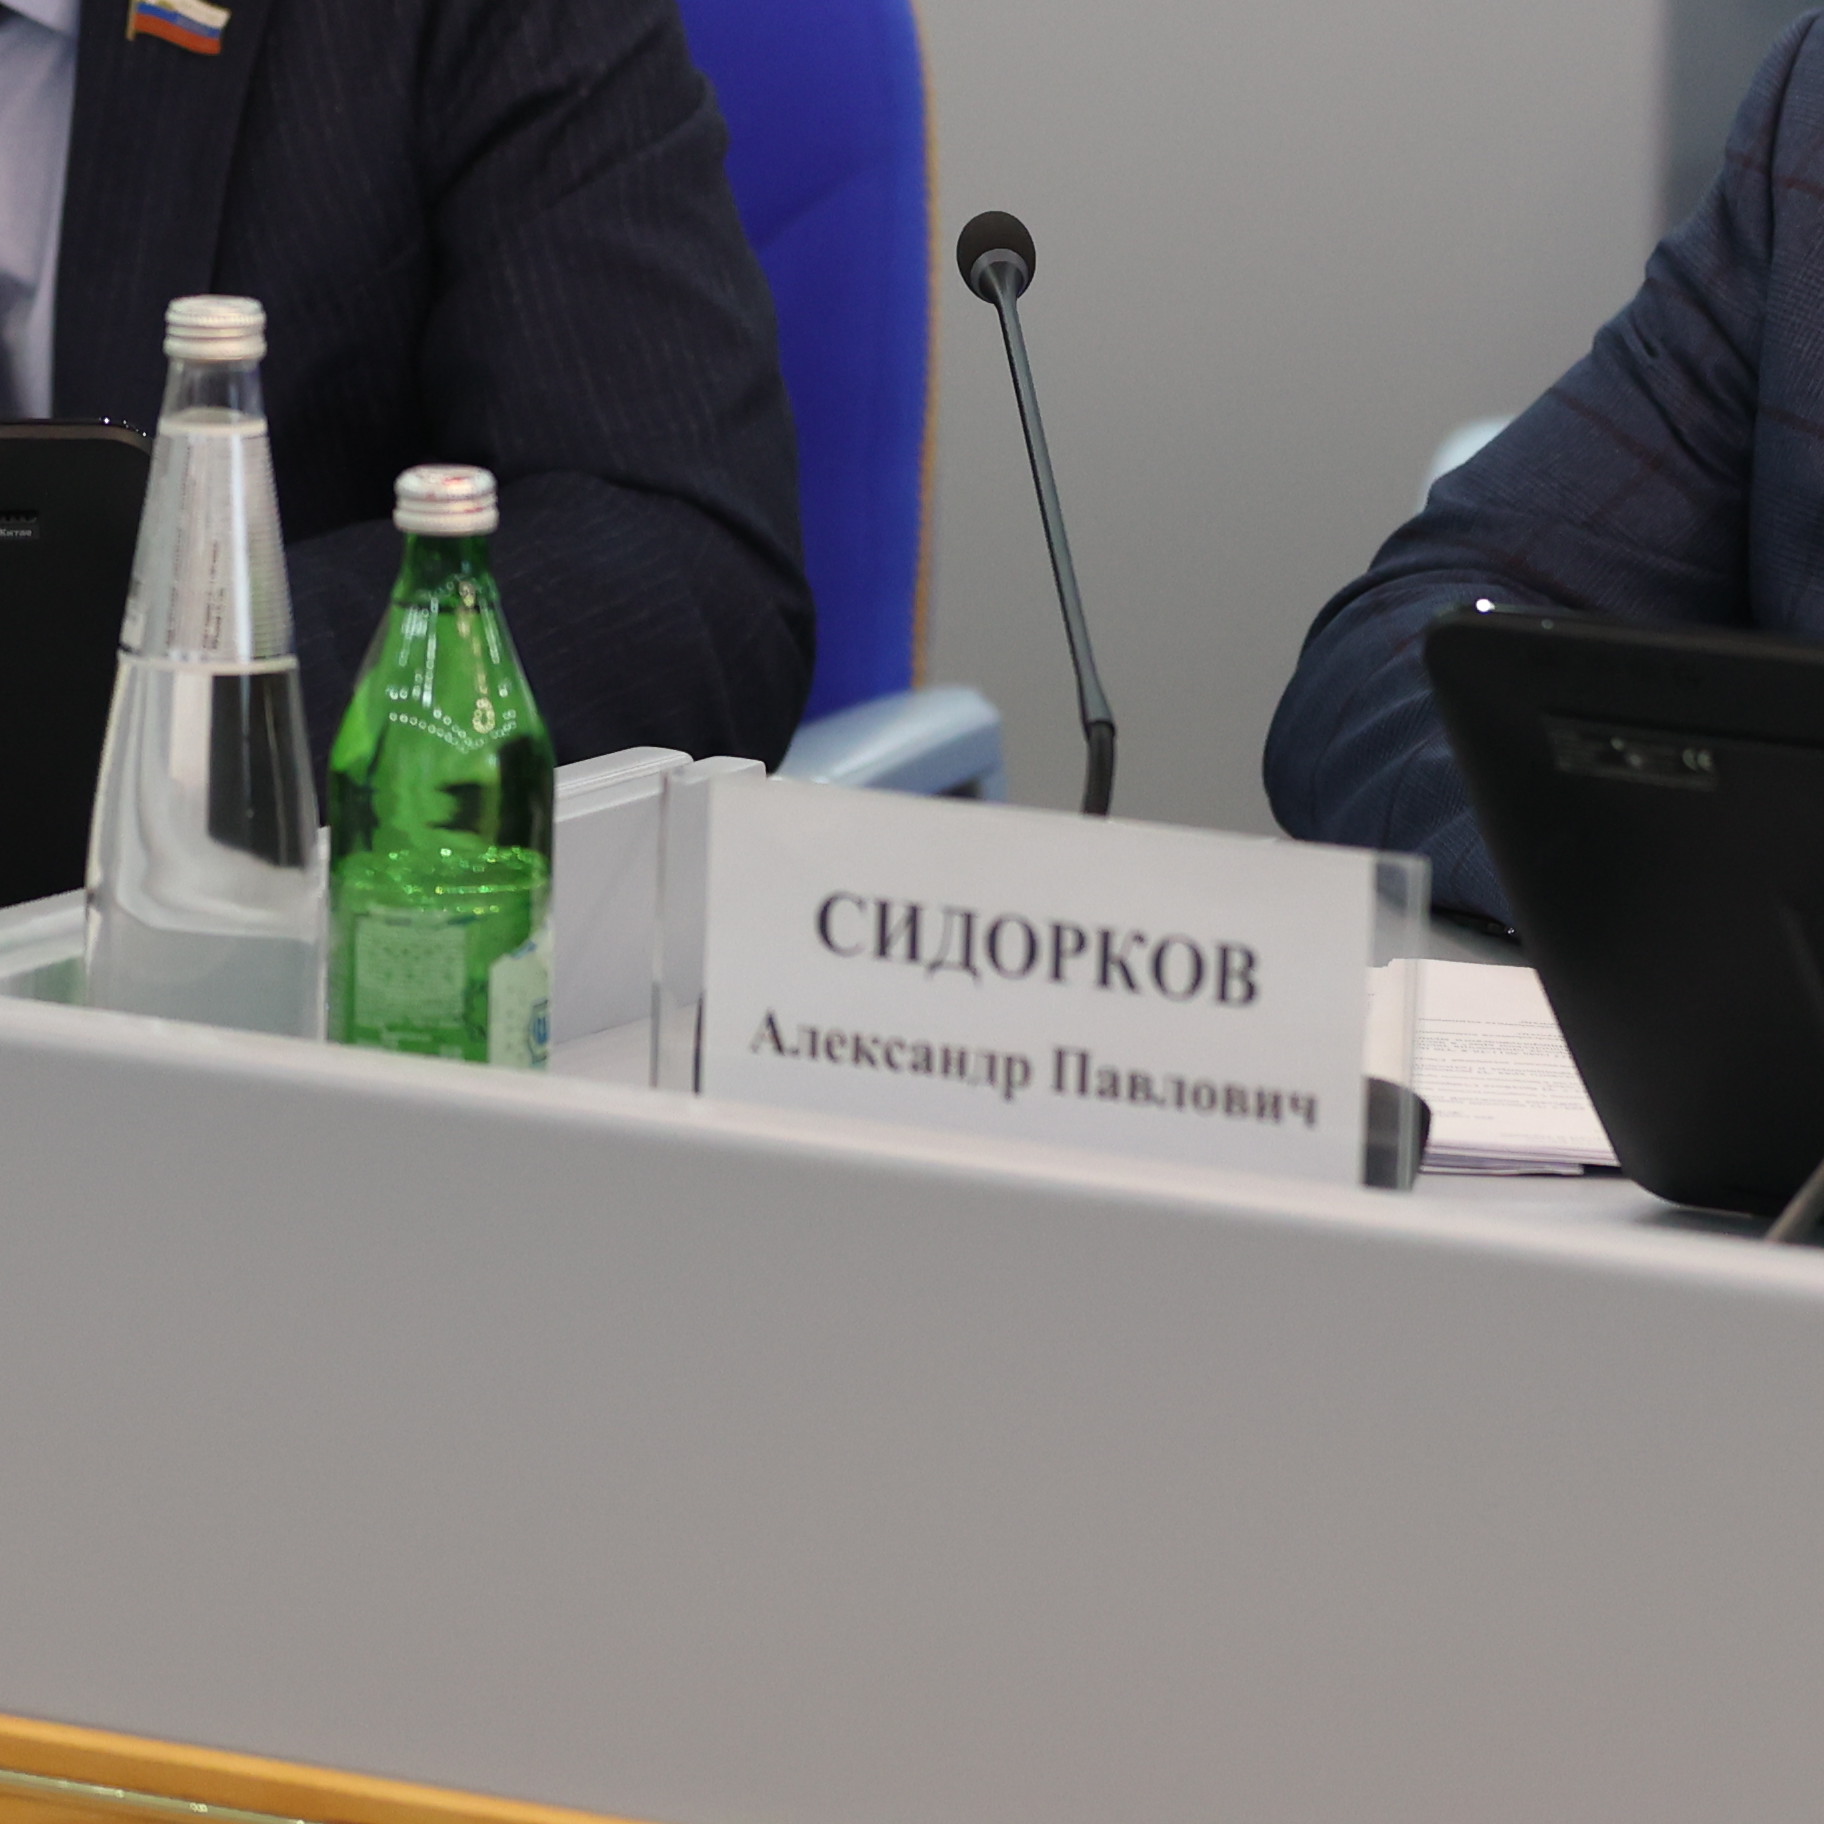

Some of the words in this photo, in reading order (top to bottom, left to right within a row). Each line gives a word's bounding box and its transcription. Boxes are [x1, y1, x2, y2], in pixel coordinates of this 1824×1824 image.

[0, 527, 33, 537] Китае
[816, 890, 1261, 1008] СИДОРКОВ
[750, 1010, 1031, 1102] Александр
[1051, 1047, 1320, 1128] Павлович
